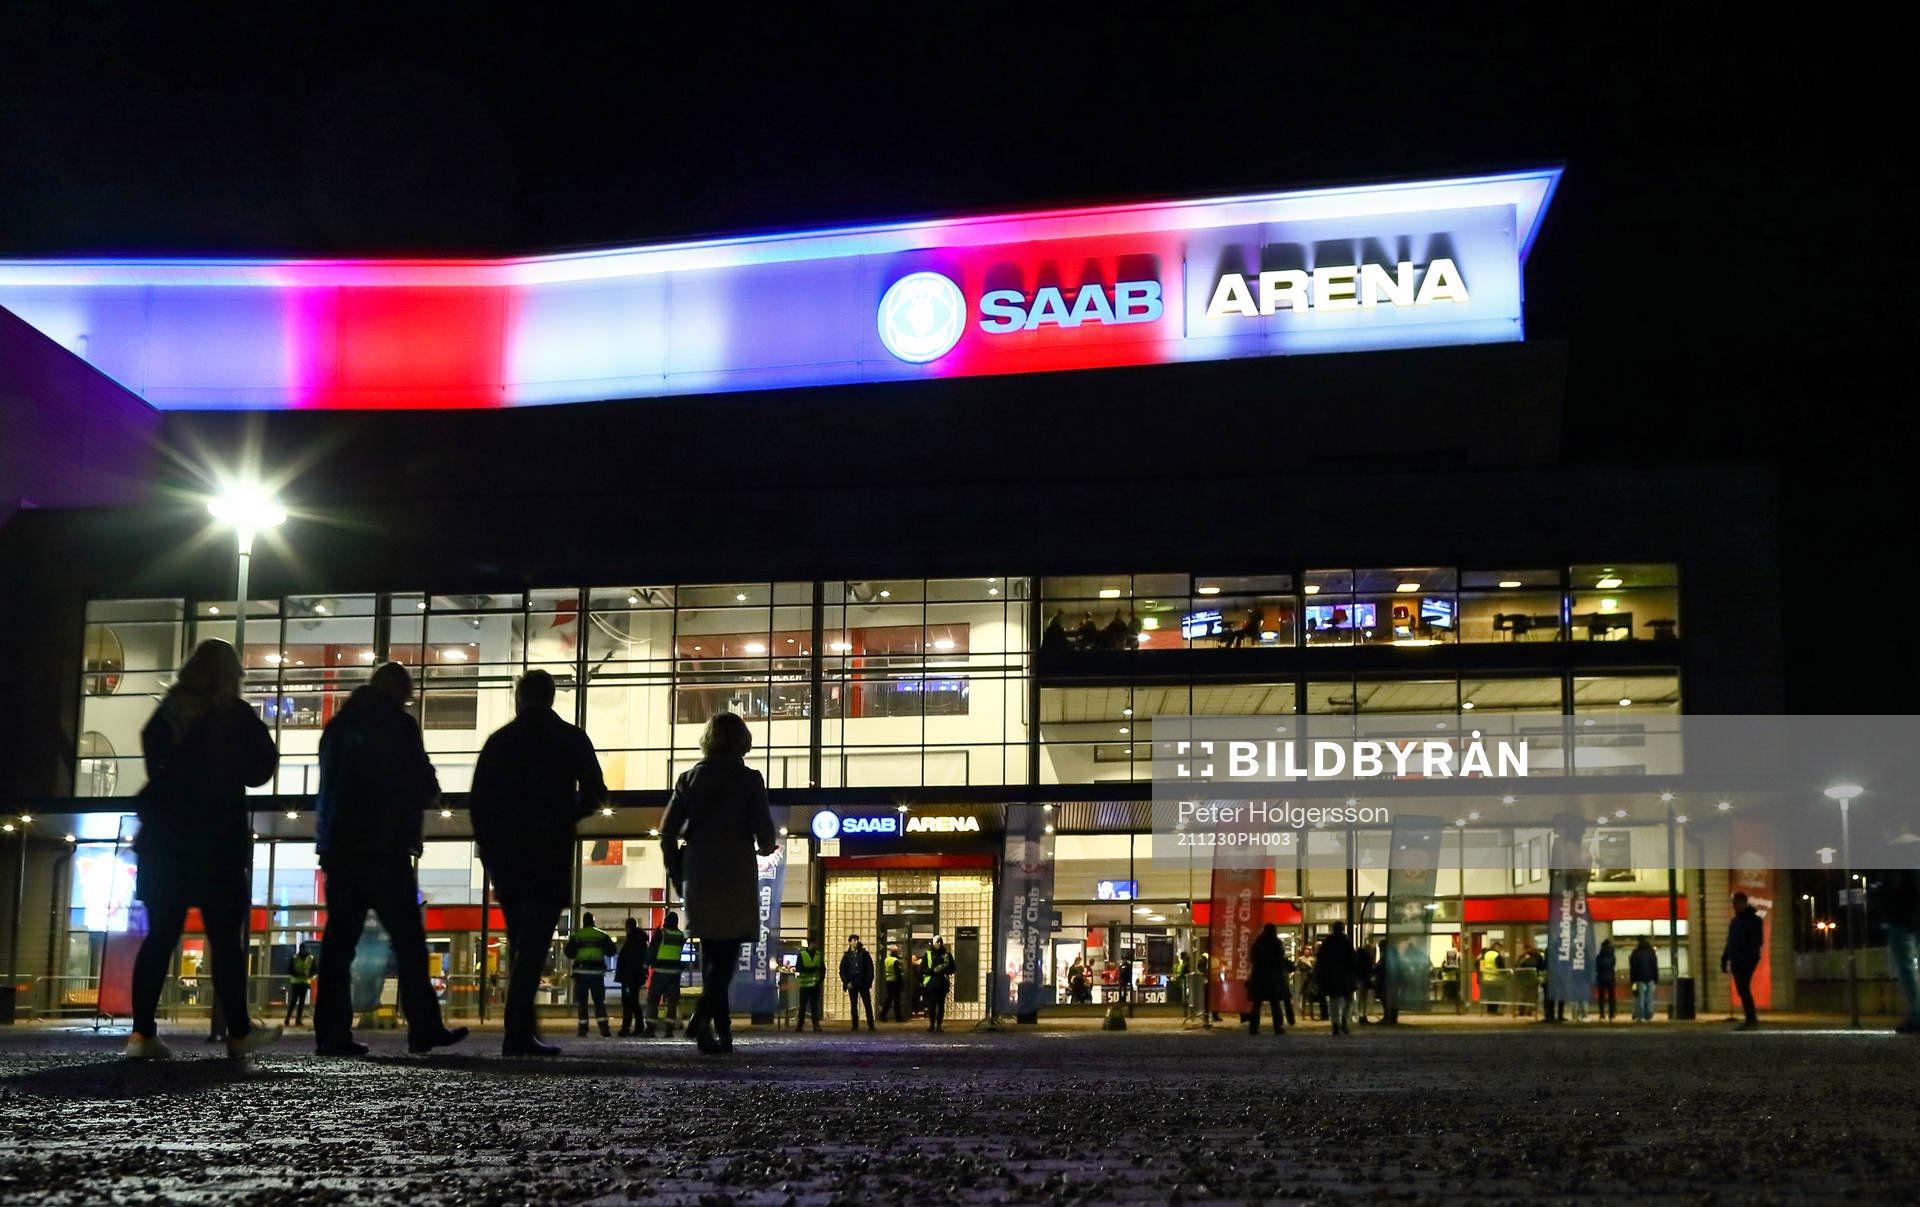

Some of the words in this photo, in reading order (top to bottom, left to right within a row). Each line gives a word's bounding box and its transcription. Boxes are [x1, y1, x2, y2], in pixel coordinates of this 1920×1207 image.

[979, 280, 1163, 333] SAAB
[1207, 259, 1469, 318] ARENA
[842, 817, 896, 832] SAAB
[906, 816, 980, 832] ARENA
[759, 886, 771, 921] Club
[1026, 887, 1040, 922] Club
[1239, 888, 1252, 921] Club
[1558, 890, 1574, 961] Linköping
[754, 923, 770, 981] Hockey
[1024, 926, 1039, 983] Hockey
[1236, 926, 1251, 981] Hockey
[1573, 917, 1588, 970] Hockey
